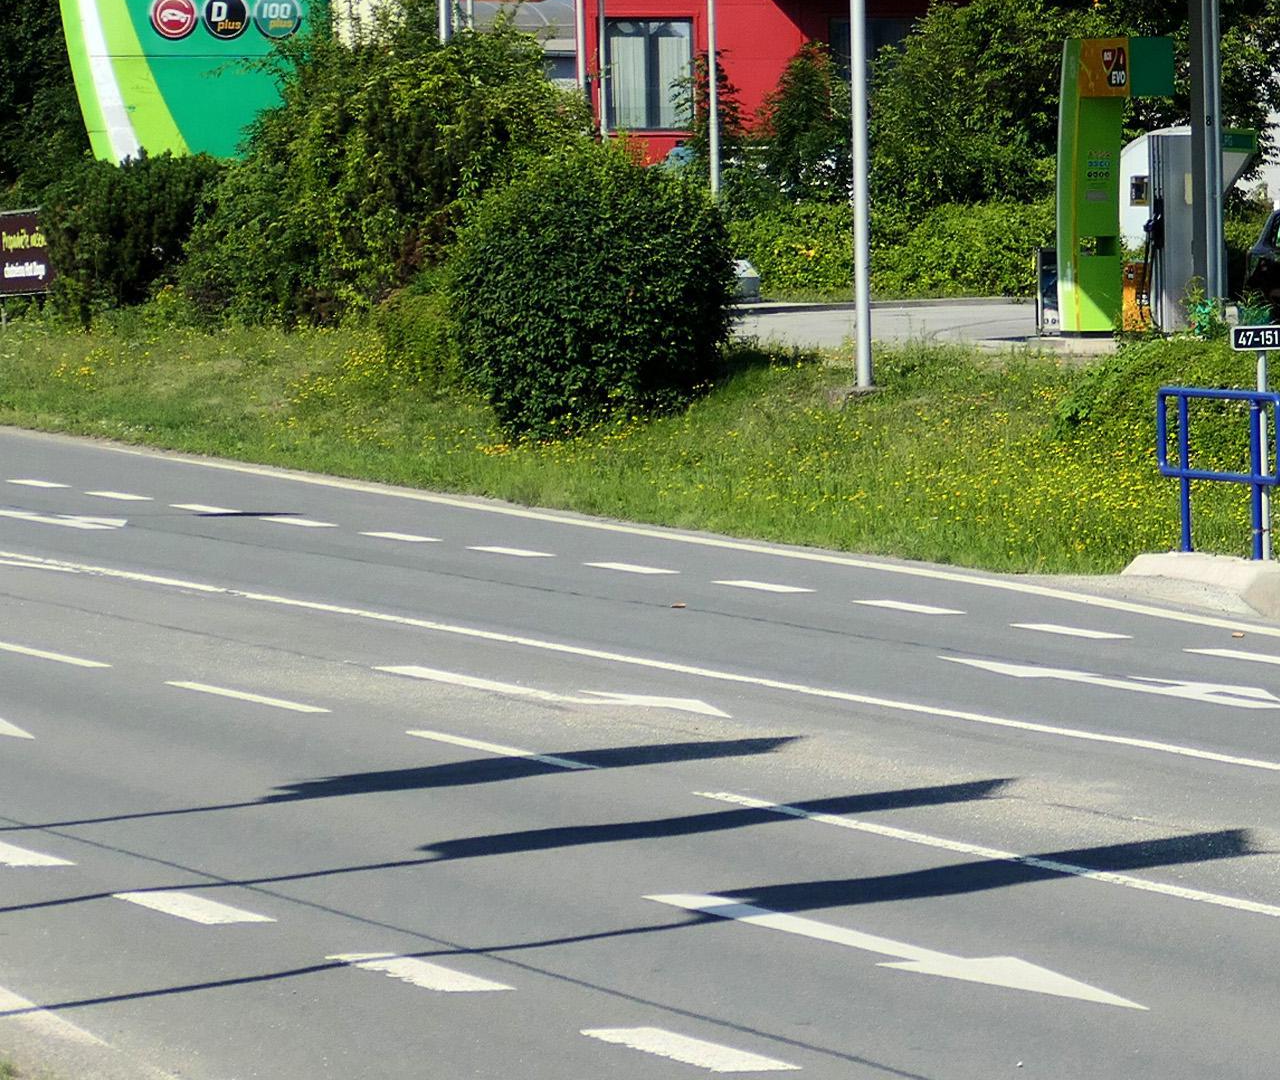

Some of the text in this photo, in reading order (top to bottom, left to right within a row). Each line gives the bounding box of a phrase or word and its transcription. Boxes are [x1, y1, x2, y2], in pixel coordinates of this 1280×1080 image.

[211, 1, 228, 22] D
[262, 3, 292, 19] 100
[217, 19, 242, 32] plus
[1111, 70, 1126, 84] EVO
[1237, 329, 1279, 346] 47-151
